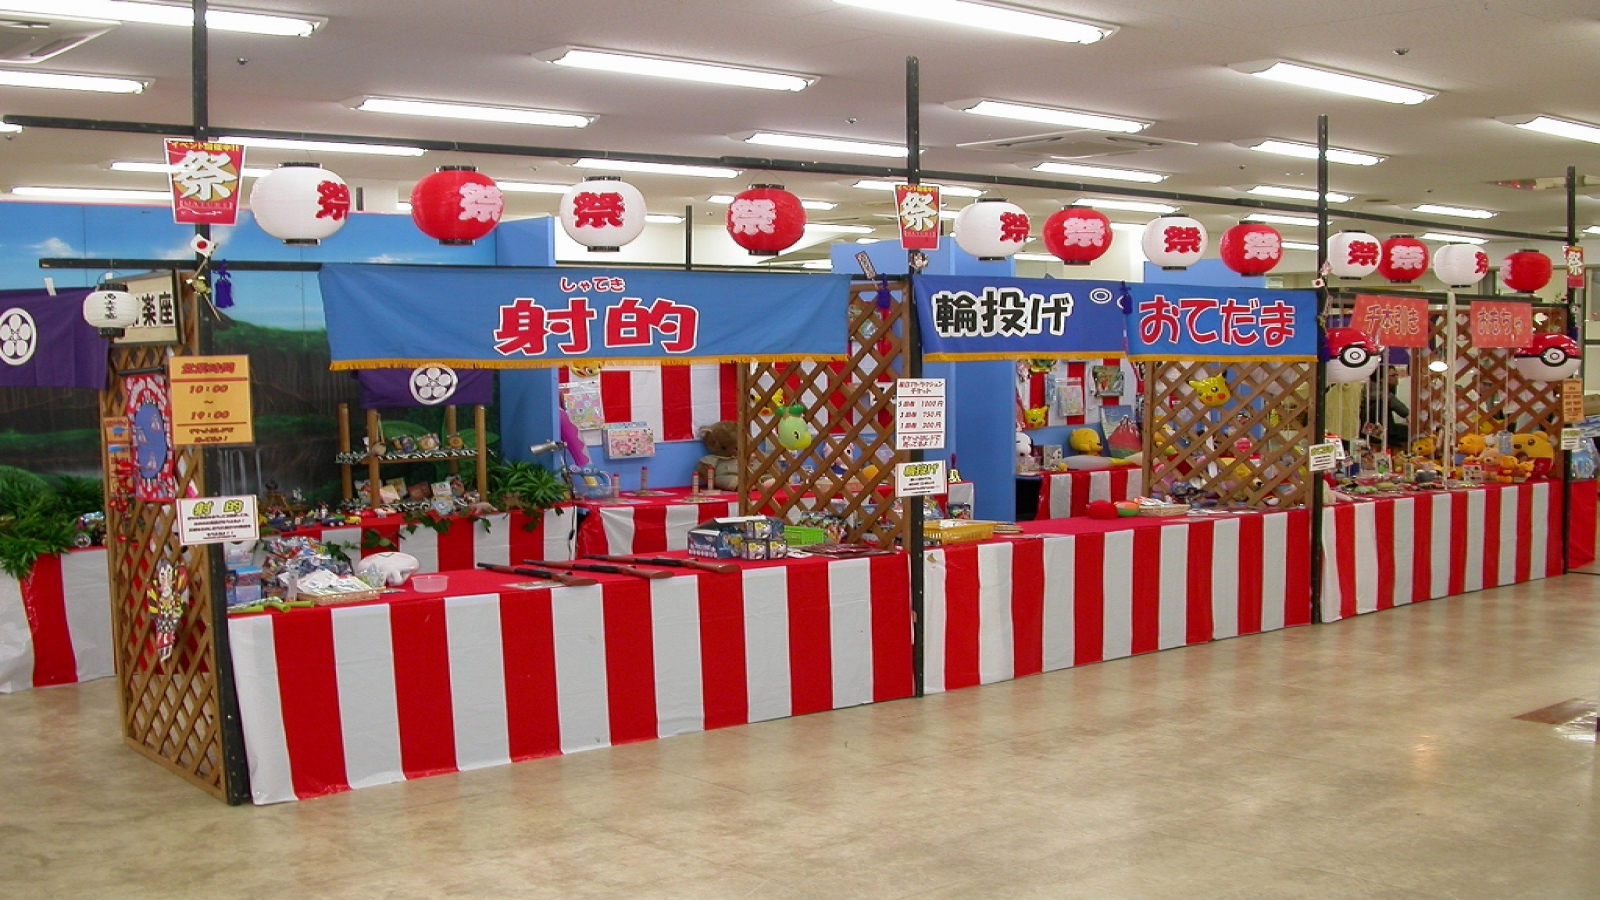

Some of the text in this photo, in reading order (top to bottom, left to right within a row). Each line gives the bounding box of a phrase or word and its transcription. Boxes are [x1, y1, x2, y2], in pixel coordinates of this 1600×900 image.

[173, 150, 238, 202] 祭
[315, 180, 350, 222] 祭
[459, 183, 504, 223] 祭
[573, 191, 626, 229] 祭
[730, 198, 776, 235] 祭
[899, 192, 939, 232] 祭
[999, 211, 1030, 243] 祭
[1063, 217, 1106, 248] 祭
[1163, 226, 1202, 254] 祭
[1243, 231, 1280, 260] 祭
[1347, 239, 1379, 267] 祭
[1390, 245, 1425, 270] 祭
[560, 276, 626, 293] しゃてき
[493, 297, 699, 356] 射的
[932, 287, 1074, 337] 輪投げ
[1138, 294, 1296, 348] おてだま
[1364, 304, 1420, 335] 千本引き
[1477, 306, 1523, 336] おもちゃ
